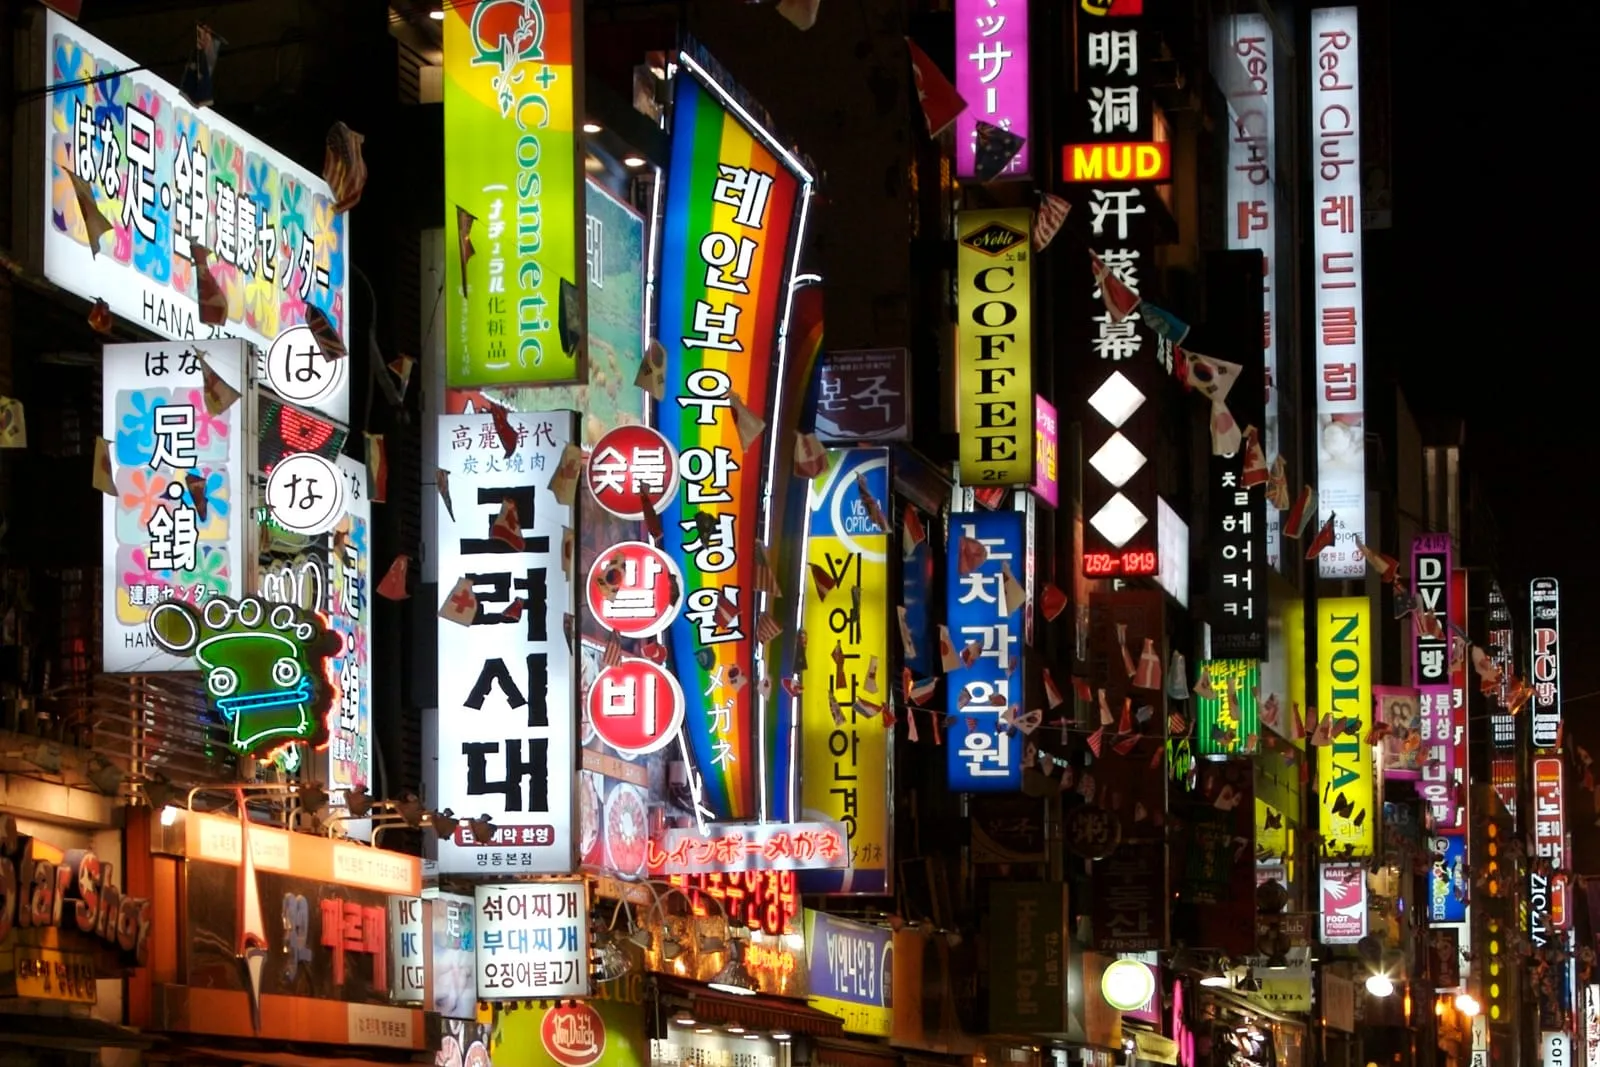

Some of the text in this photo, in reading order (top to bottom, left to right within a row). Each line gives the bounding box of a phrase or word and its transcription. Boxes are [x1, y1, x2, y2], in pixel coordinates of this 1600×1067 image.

[1087, 29, 1139, 134] 明洞
[1319, 30, 1354, 182] Red Club
[1073, 145, 1162, 180] MUD
[515, 93, 549, 368] Cosmetic
[972, 229, 1015, 249] Noble
[142, 289, 197, 341] HANA
[145, 350, 202, 376] はな
[971, 266, 1018, 464] COFFEE
[676, 164, 776, 646] 레인보우안경원
[592, 446, 667, 495] 숯불
[981, 468, 1009, 482] 2F
[284, 473, 323, 510] な
[1084, 554, 1155, 573] 752-1919
[124, 632, 156, 650] HAN
[460, 484, 554, 813] 고려시대
[1534, 628, 1558, 706] PC방
[602, 673, 656, 736] 비
[704, 664, 736, 772] メガネ
[522, 828, 548, 844] 환영
[646, 831, 842, 870] レインボーメガネ
[476, 852, 533, 867] 명동본점
[482, 891, 578, 921] 섞어찌개
[483, 925, 578, 955] 부대찌개
[484, 958, 580, 990] 오징어불고기
